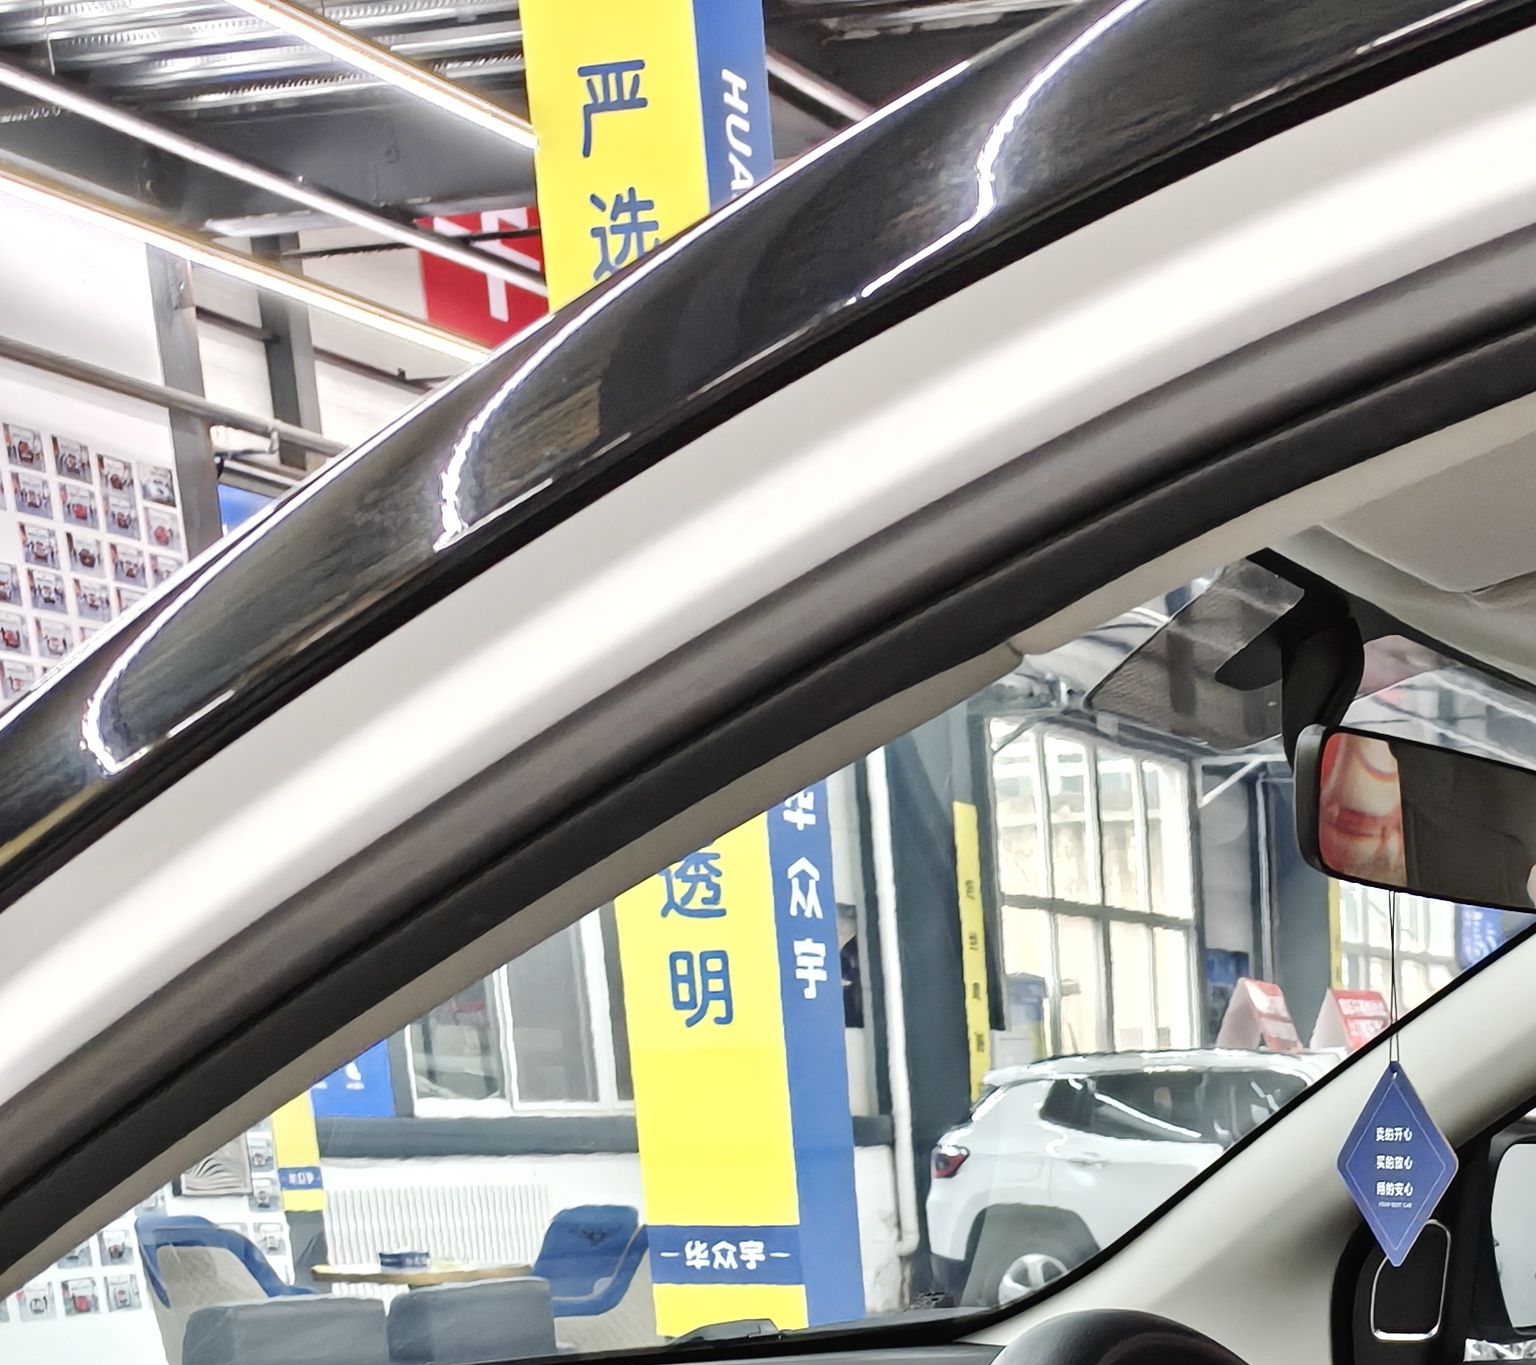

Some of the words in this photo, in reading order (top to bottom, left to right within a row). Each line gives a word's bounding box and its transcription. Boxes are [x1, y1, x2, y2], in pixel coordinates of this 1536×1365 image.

[577, 59, 660, 281] 严选
[684, 1239, 766, 1270] 华众宇
